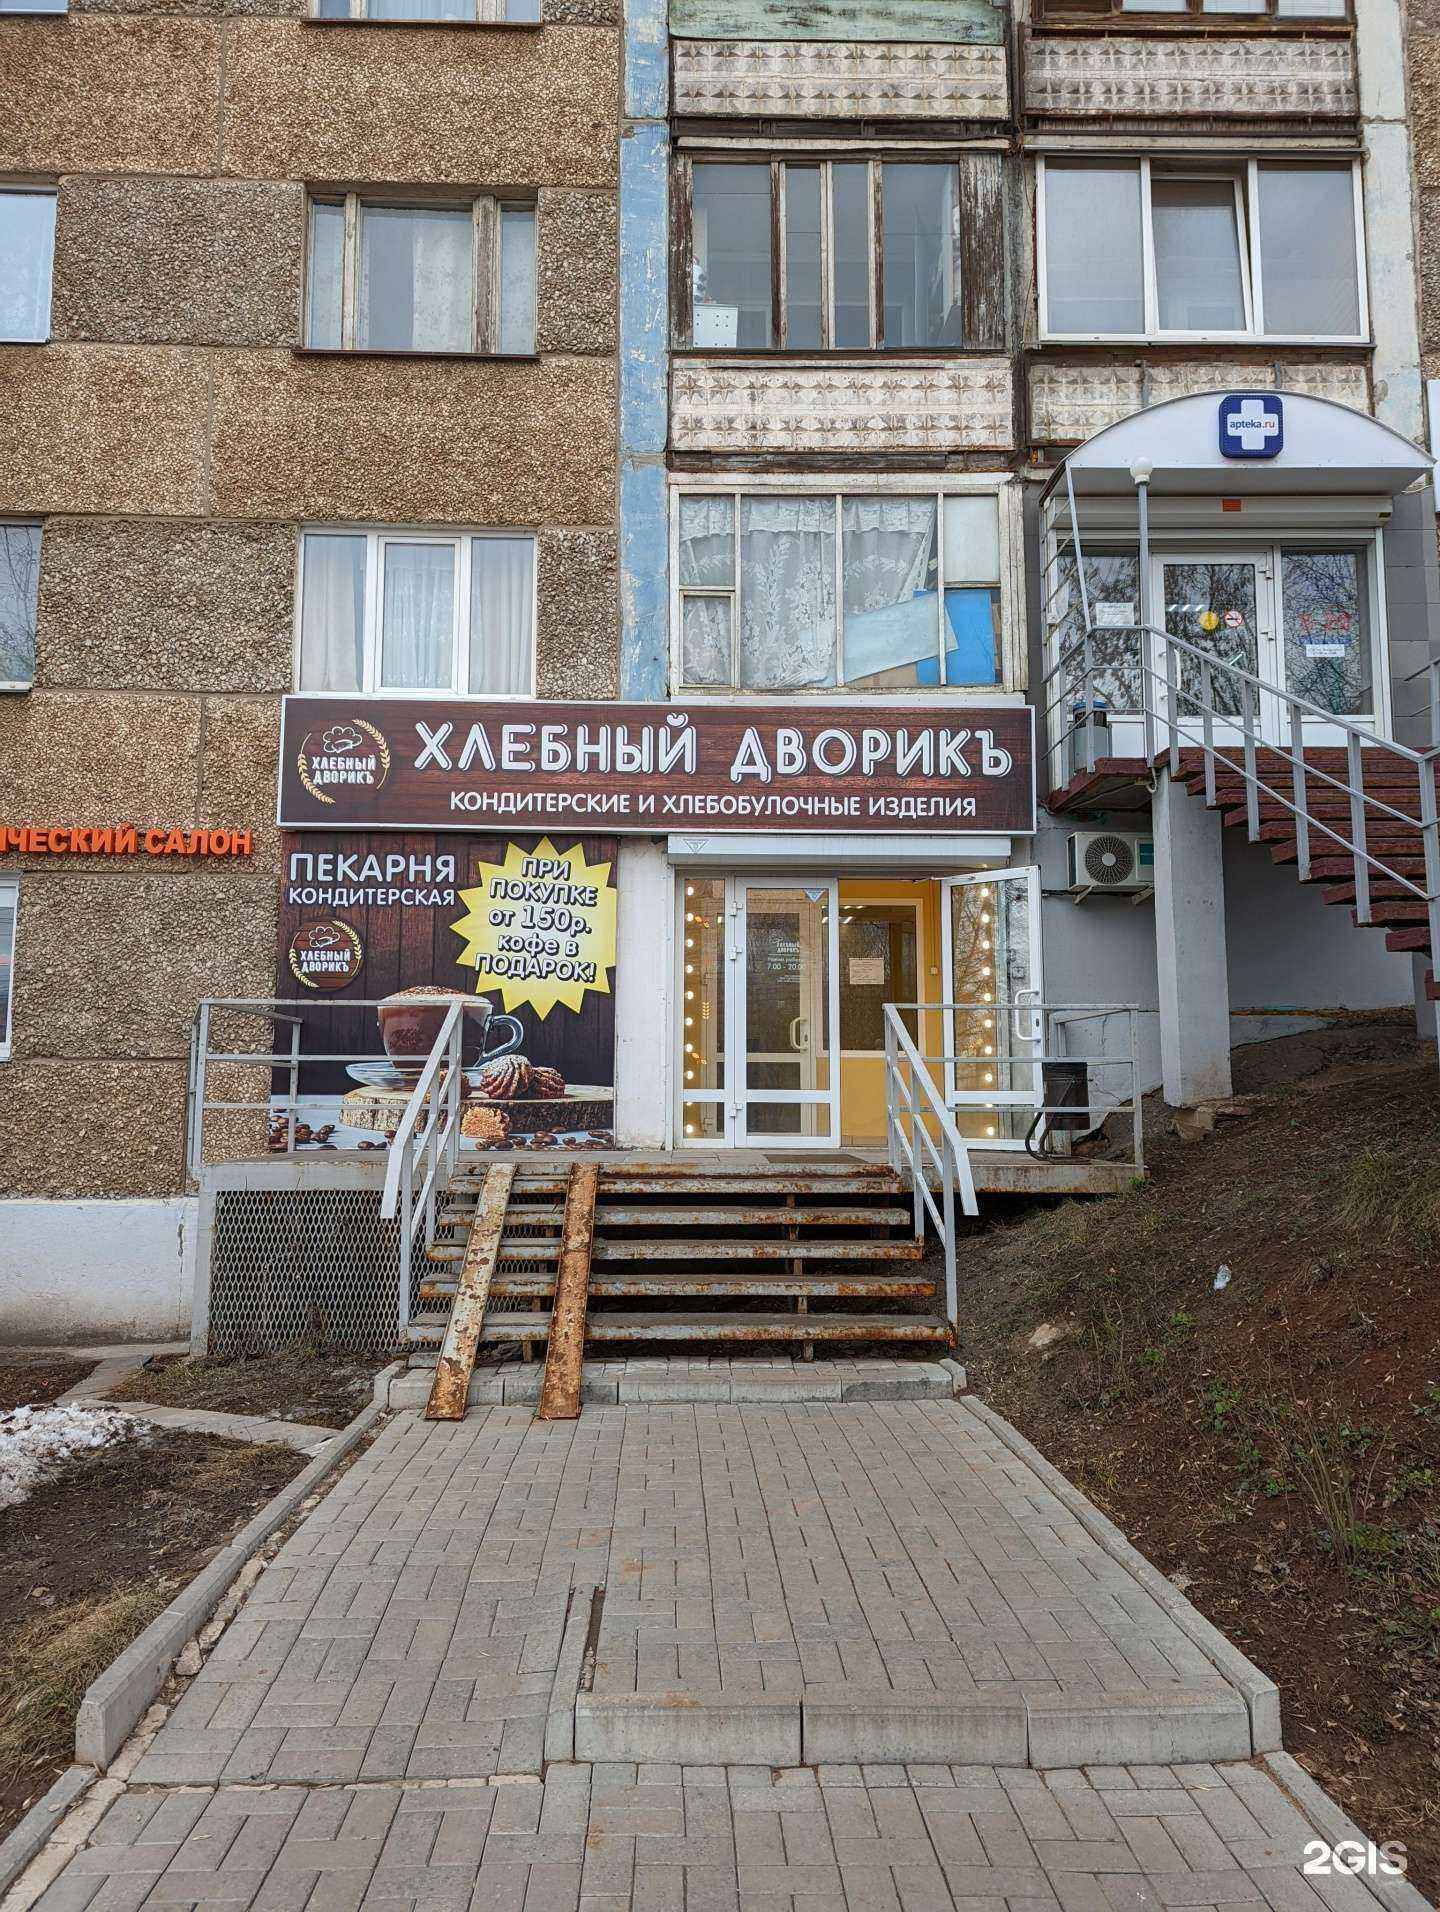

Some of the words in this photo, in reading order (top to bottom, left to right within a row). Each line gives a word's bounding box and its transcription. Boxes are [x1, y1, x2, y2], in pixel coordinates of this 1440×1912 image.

[1229, 420, 1275, 431] apteka.ru
[413, 712, 697, 775] ХЛЕБНЫЙ
[730, 726, 1012, 784] ДВОРИКЪ
[312, 755, 377, 770] ХЛЕБНЫЙ
[313, 770, 375, 785] ДВОРИКЪ
[450, 791, 631, 815] КОНДИТЕРСКИЕ
[638, 794, 655, 814] И
[662, 795, 861, 817] ХЛЕБОБУЛОЧНЫЕ
[869, 797, 977, 819] ИЗДЕЛИЯ
[144, 828, 253, 856] САЛОН
[290, 853, 455, 883] ПЕКАРНЯ
[522, 857, 571, 880] ПРИ
[289, 887, 455, 907] КОНДИТЕРСКАЯ
[489, 878, 599, 907] ПОКУПКЕ
[489, 909, 516, 927] от
[521, 905, 592, 938] 150р.
[300, 949, 351, 961] ХЛЕБНЫЙ
[498, 932, 559, 958] кофе
[565, 941, 579, 957] в
[301, 962, 350, 973] ДВОРИКЪ
[475, 953, 597, 983] ПОДАРОК!
